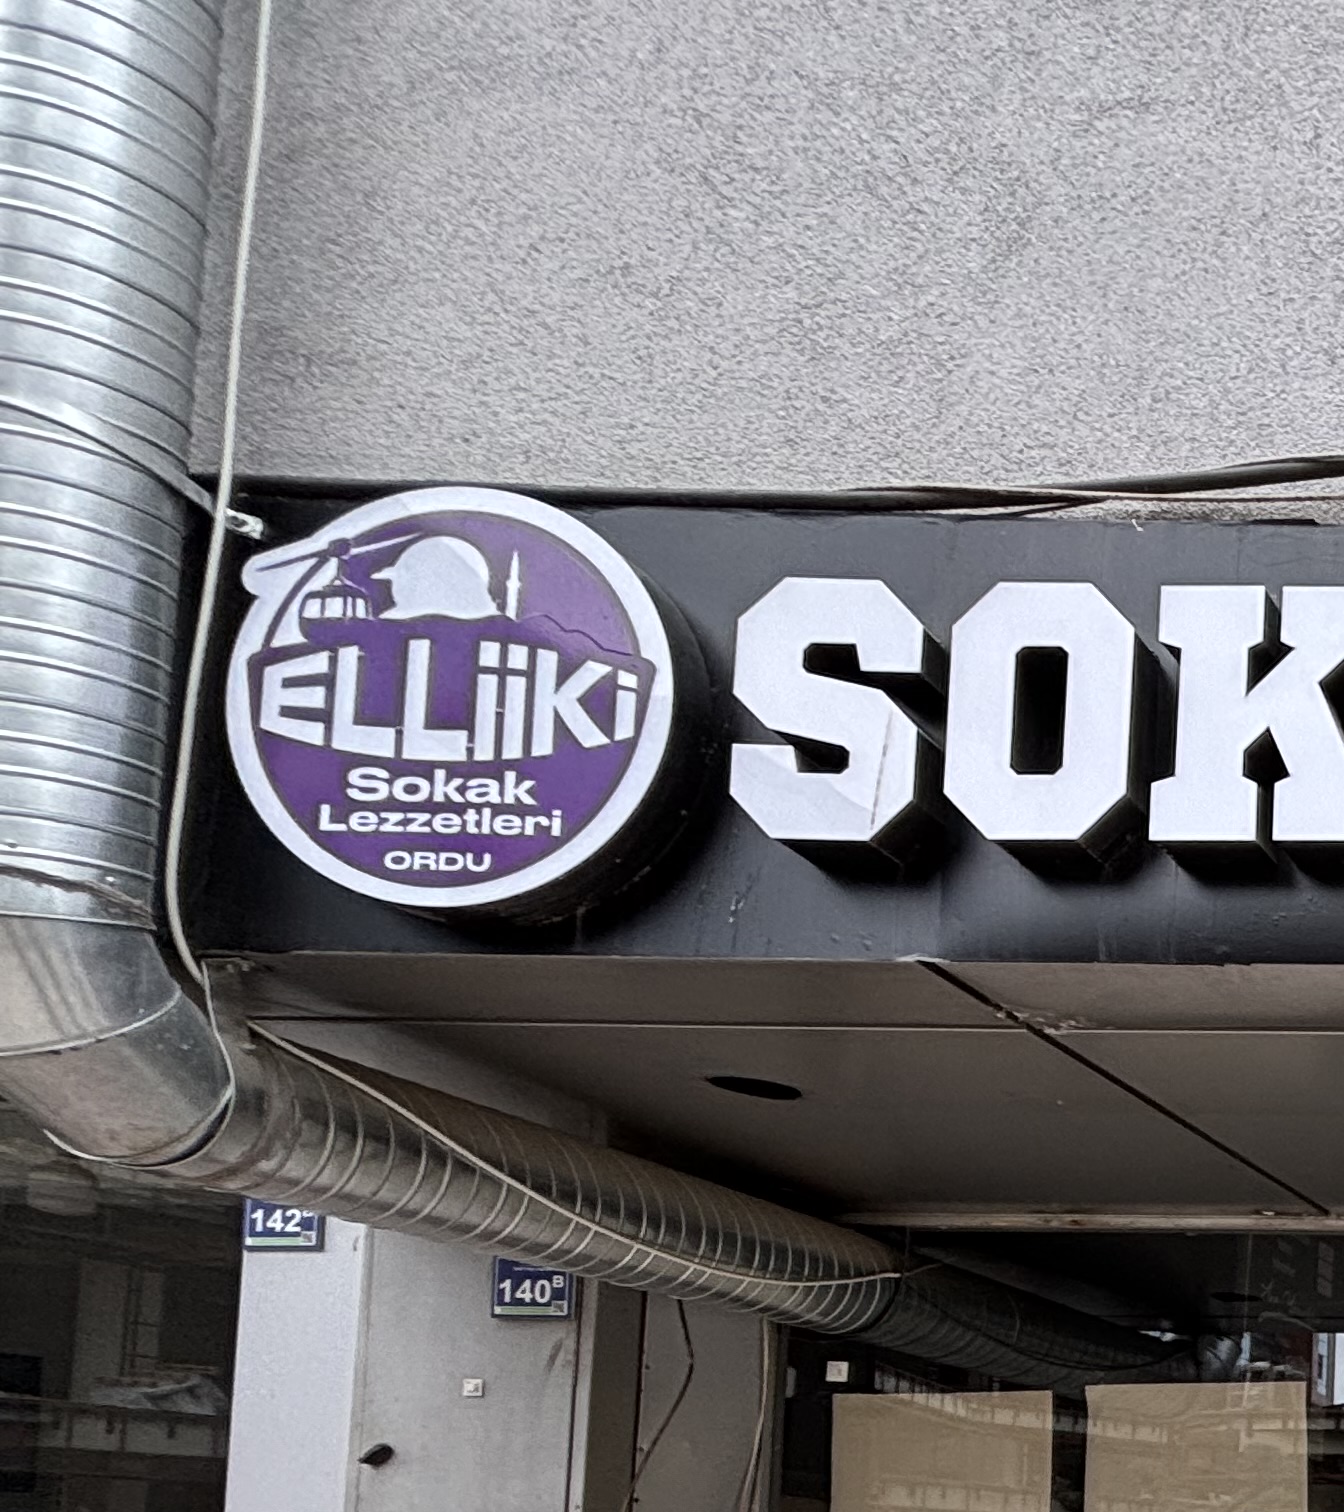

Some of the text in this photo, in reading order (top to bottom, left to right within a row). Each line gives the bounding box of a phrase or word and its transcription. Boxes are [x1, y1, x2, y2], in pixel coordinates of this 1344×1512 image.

[346, 767, 537, 806] Sokak
[319, 804, 562, 837] Lezzetleri
[384, 850, 492, 872] ORDU
